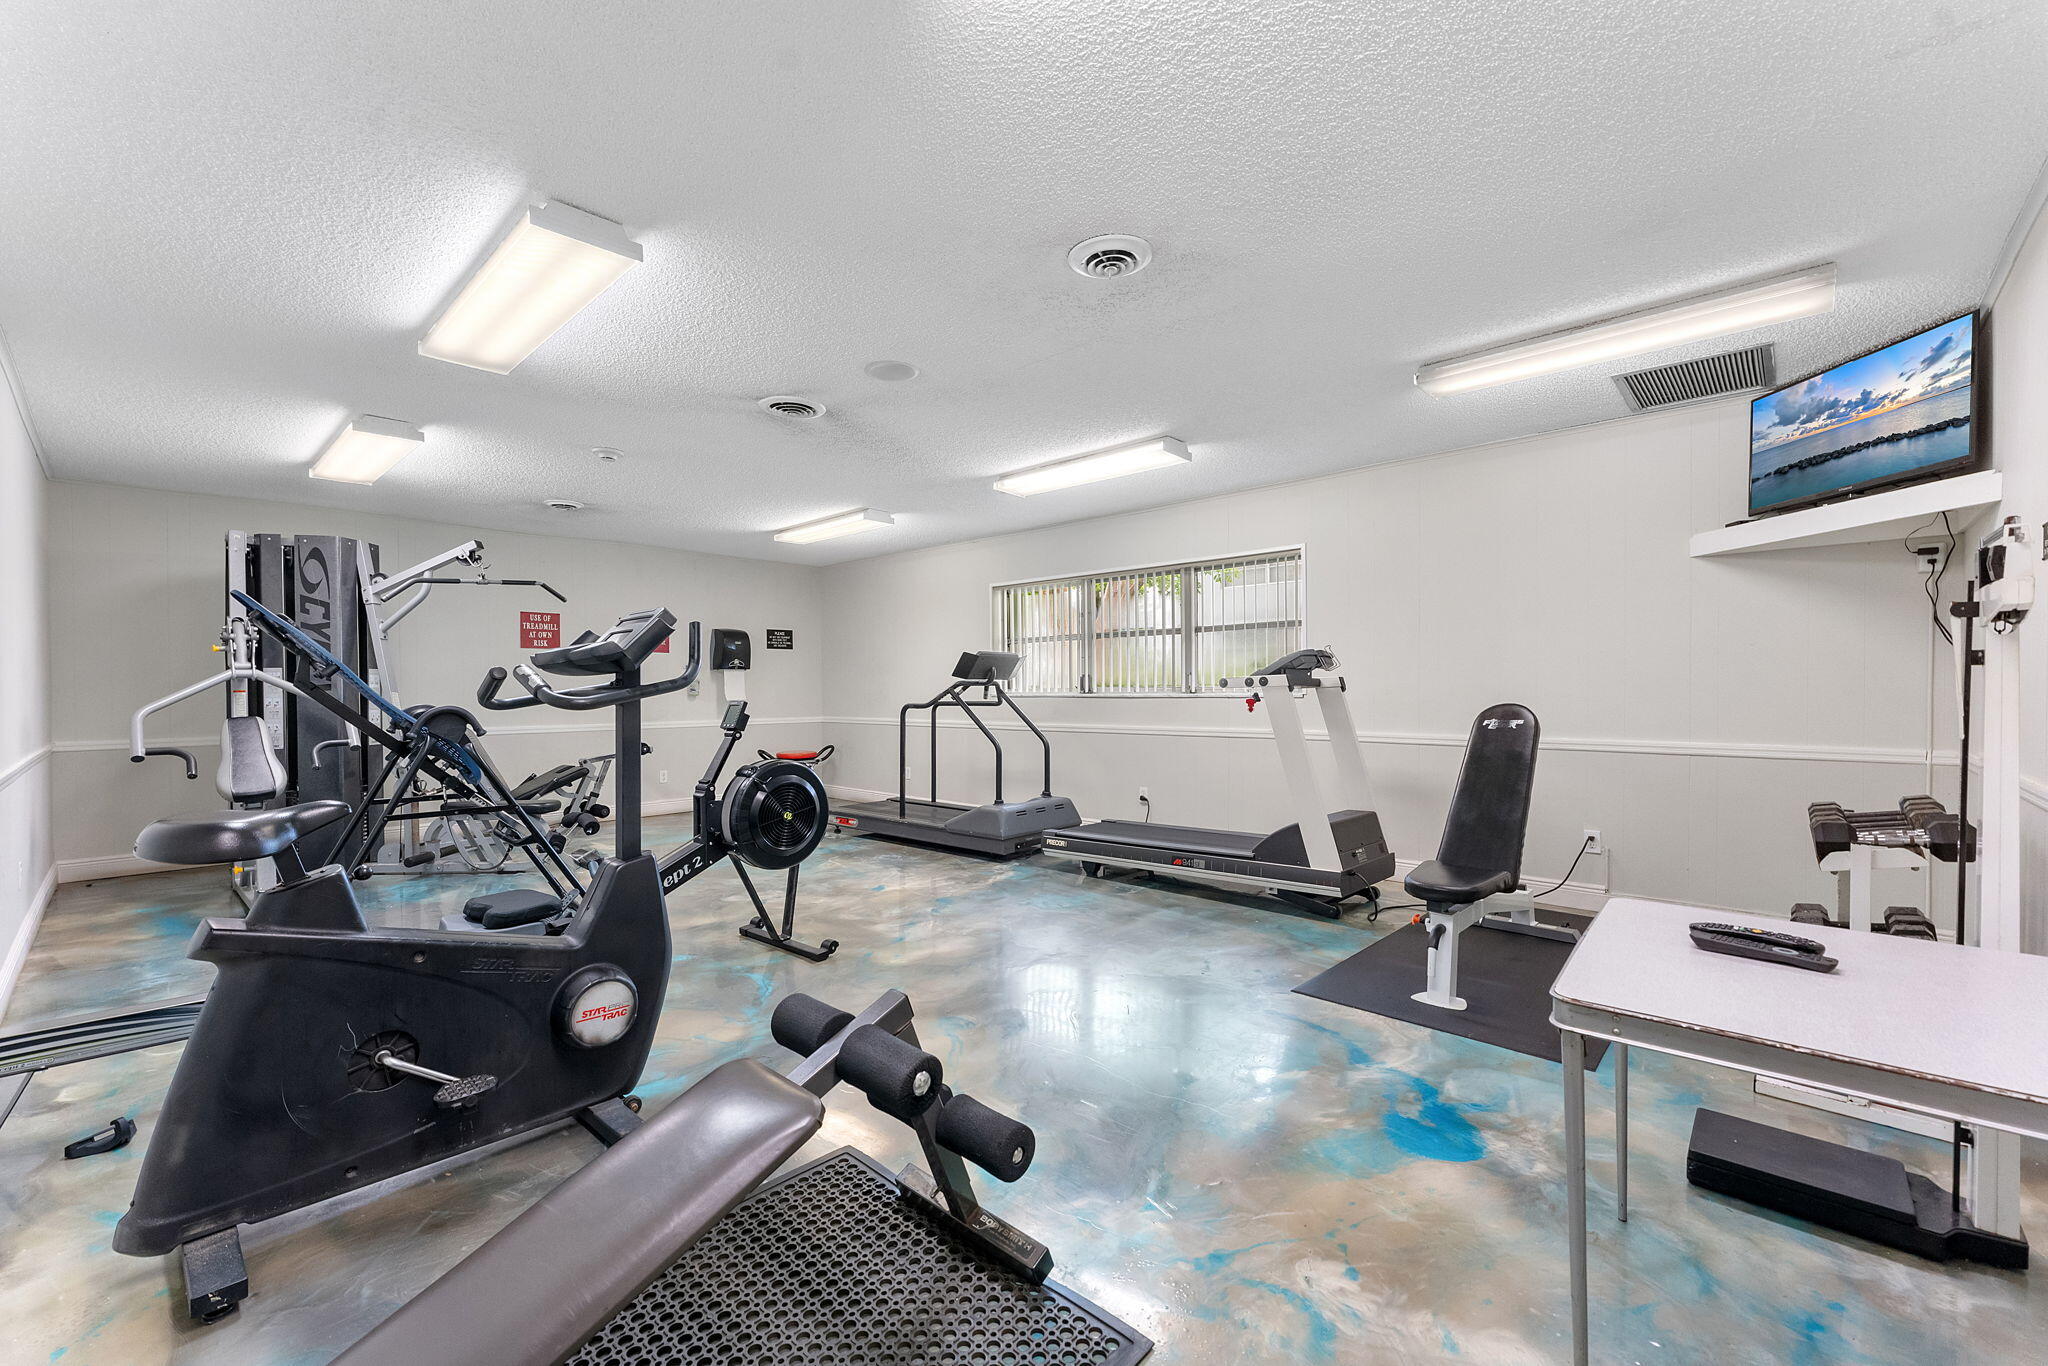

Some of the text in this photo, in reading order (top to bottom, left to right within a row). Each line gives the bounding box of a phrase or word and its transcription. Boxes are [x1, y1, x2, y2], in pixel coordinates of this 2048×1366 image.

[543, 614, 552, 622] OF
[522, 622, 559, 631] TREADMILL
[538, 631, 552, 639] OWN
[533, 639, 548, 647] RISK
[1046, 838, 1065, 847] PRECOR
[663, 856, 703, 888] ept 2
[582, 1006, 607, 1018] STAR
[601, 1009, 628, 1021] TRAC
